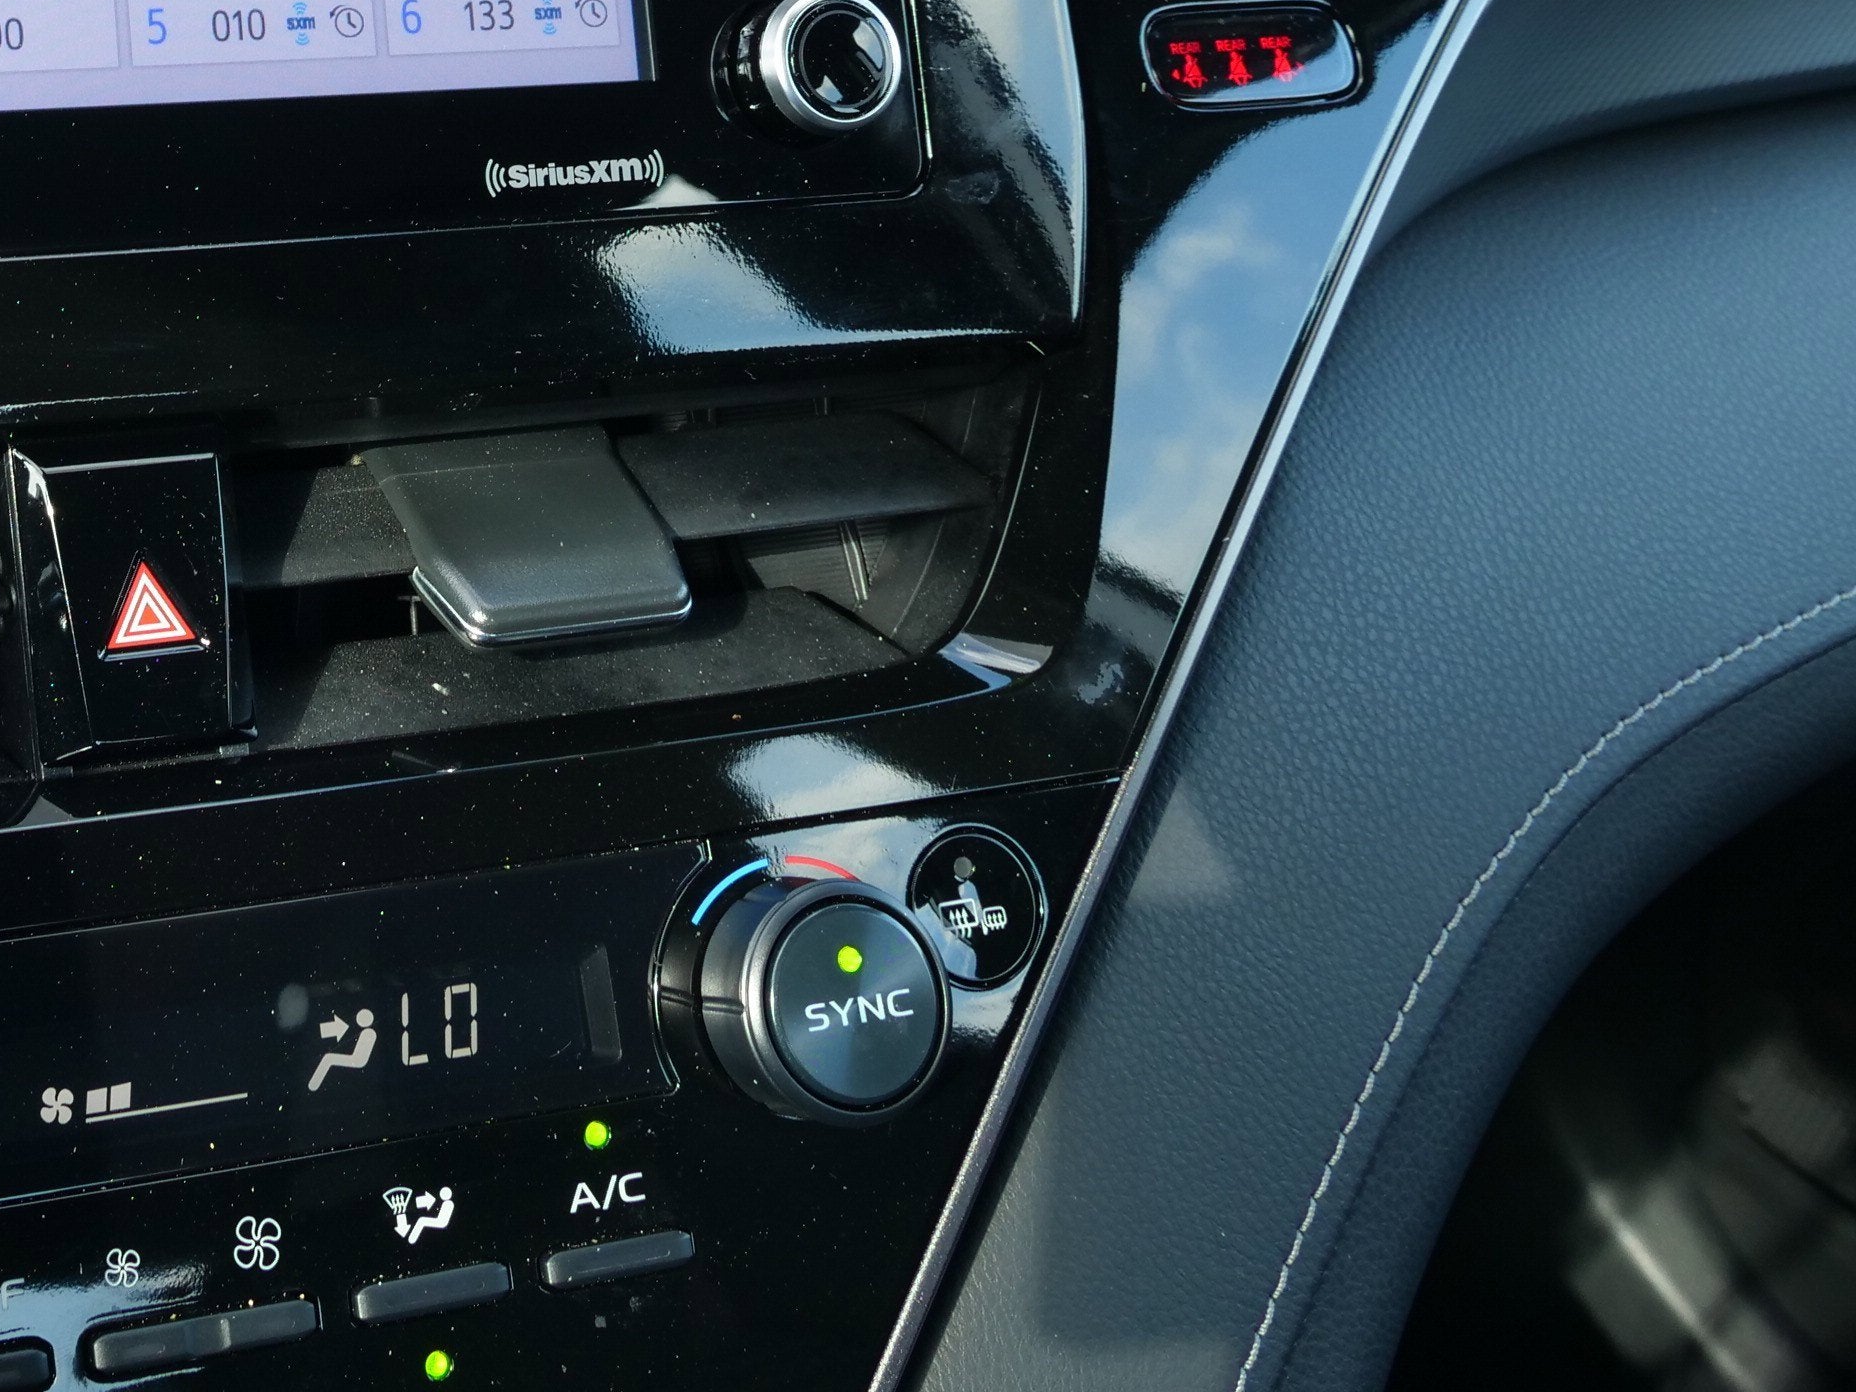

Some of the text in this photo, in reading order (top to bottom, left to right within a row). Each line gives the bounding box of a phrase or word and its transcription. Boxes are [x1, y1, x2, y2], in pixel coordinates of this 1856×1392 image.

[148, 8, 168, 45] 5
[212, 9, 267, 42] 010
[463, 0, 516, 32] 133
[1169, 42, 1202, 55] REAR
[1215, 39, 1247, 52] REAR
[1259, 36, 1293, 49] REAR
[401, 981, 479, 1067] LO
[804, 988, 915, 1033] SYNC
[569, 1171, 647, 1214] A/C
